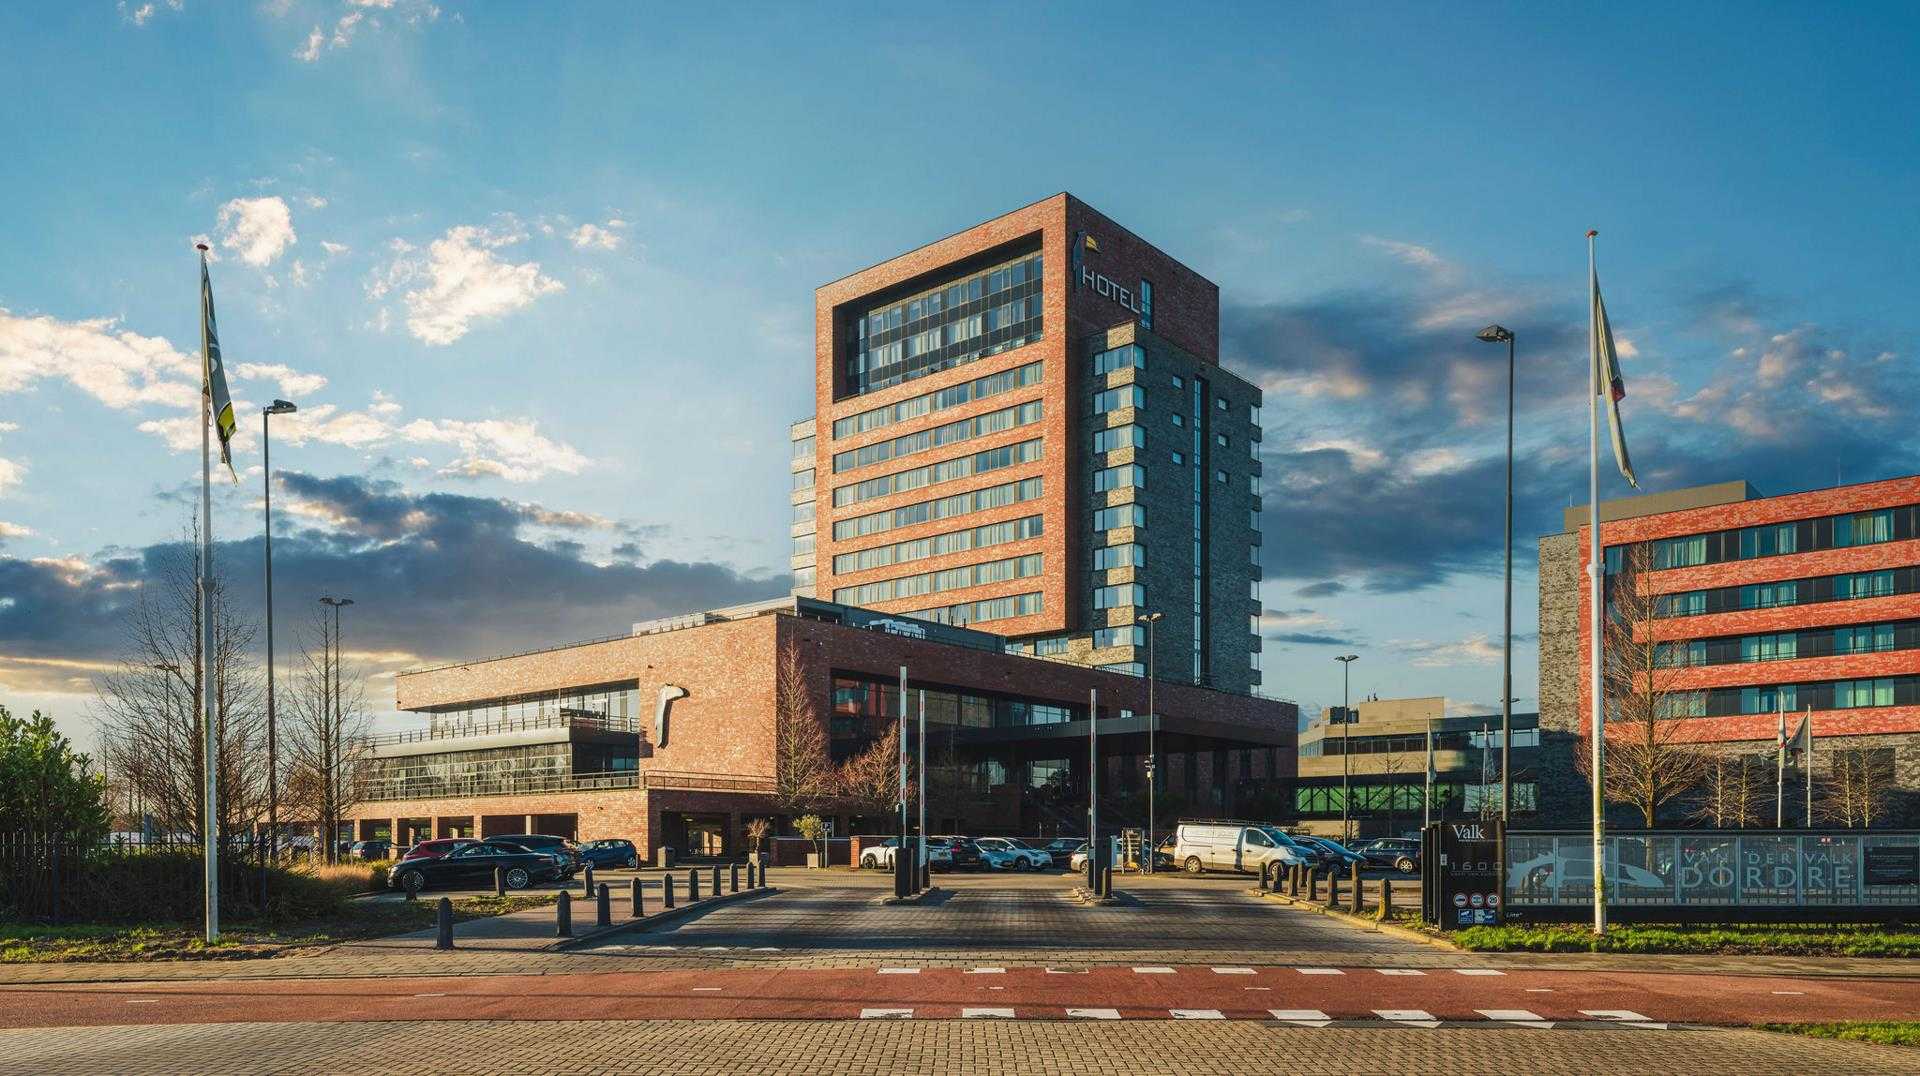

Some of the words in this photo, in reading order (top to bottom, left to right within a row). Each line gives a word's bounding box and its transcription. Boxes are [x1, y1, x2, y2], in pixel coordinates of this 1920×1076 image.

[1082, 265, 1140, 314] HOTEL
[1453, 824, 1485, 839] Valk
[1684, 852, 1728, 864] VAN
[1748, 853, 1792, 864] DER
[1804, 853, 1852, 864] VALK
